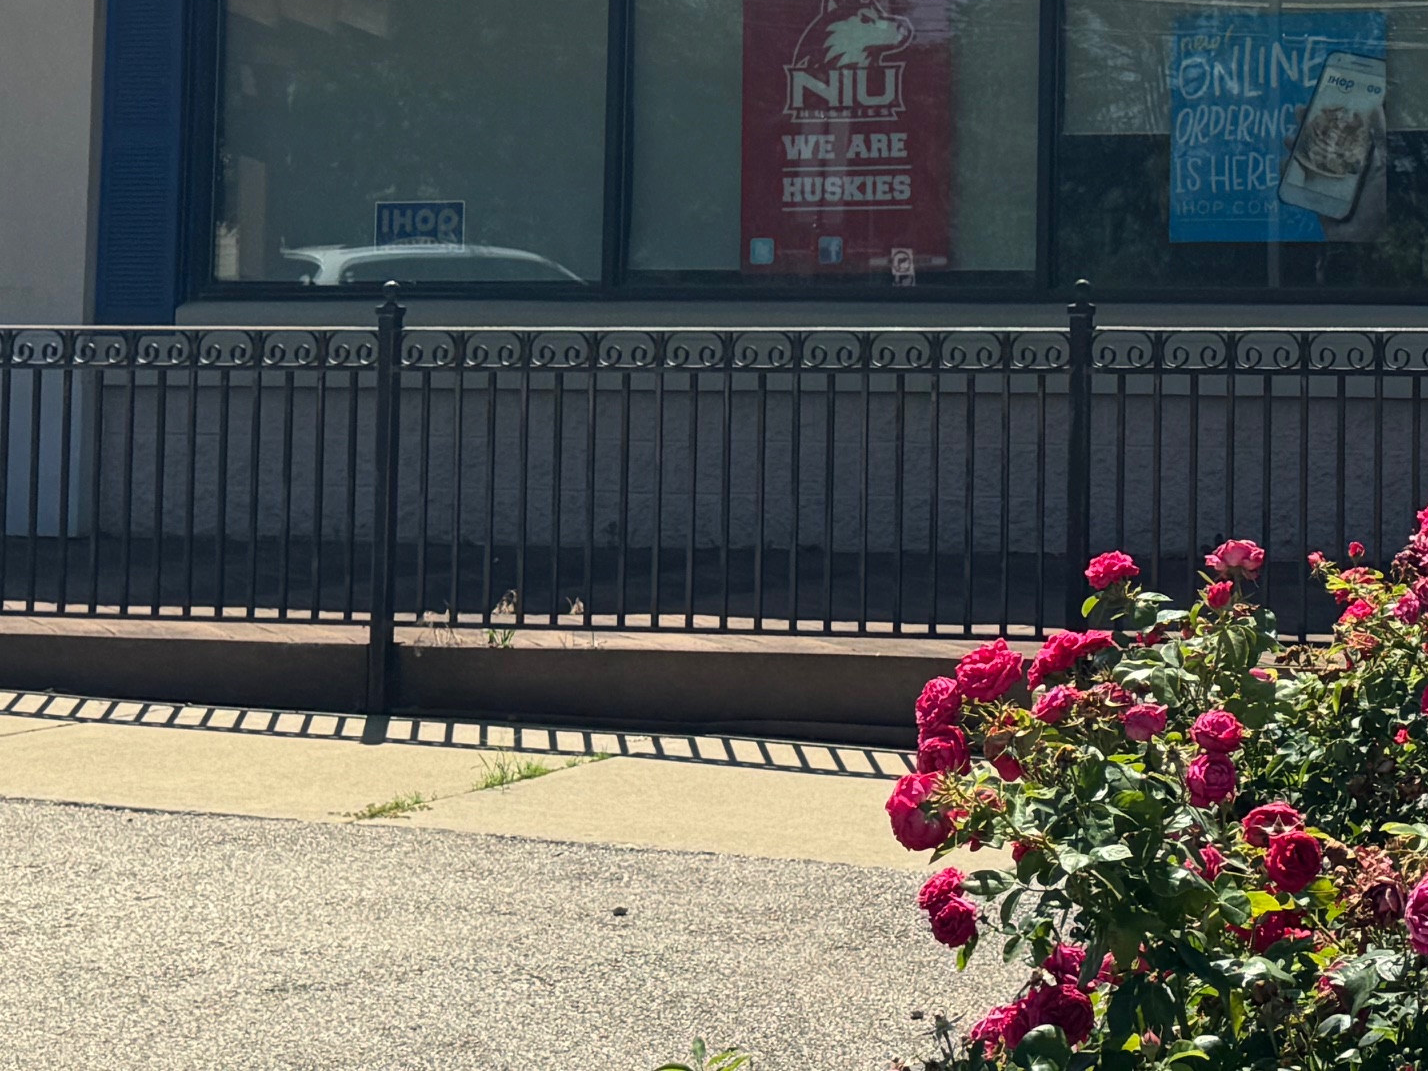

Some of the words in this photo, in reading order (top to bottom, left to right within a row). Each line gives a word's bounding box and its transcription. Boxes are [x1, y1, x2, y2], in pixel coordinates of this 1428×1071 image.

[1178, 36, 1324, 99] ONLINE
[792, 68, 897, 108] NIU
[1327, 75, 1355, 90] IHOP
[799, 108, 889, 118] HUSKIES
[1175, 103, 1298, 146] ORDERING
[781, 134, 836, 160] WE
[847, 133, 908, 159] ARE
[1175, 157, 1202, 193] IS
[1210, 151, 1280, 193] HERE
[781, 175, 912, 202] HUSKIES
[1175, 199, 1279, 216] IHOP.COM
